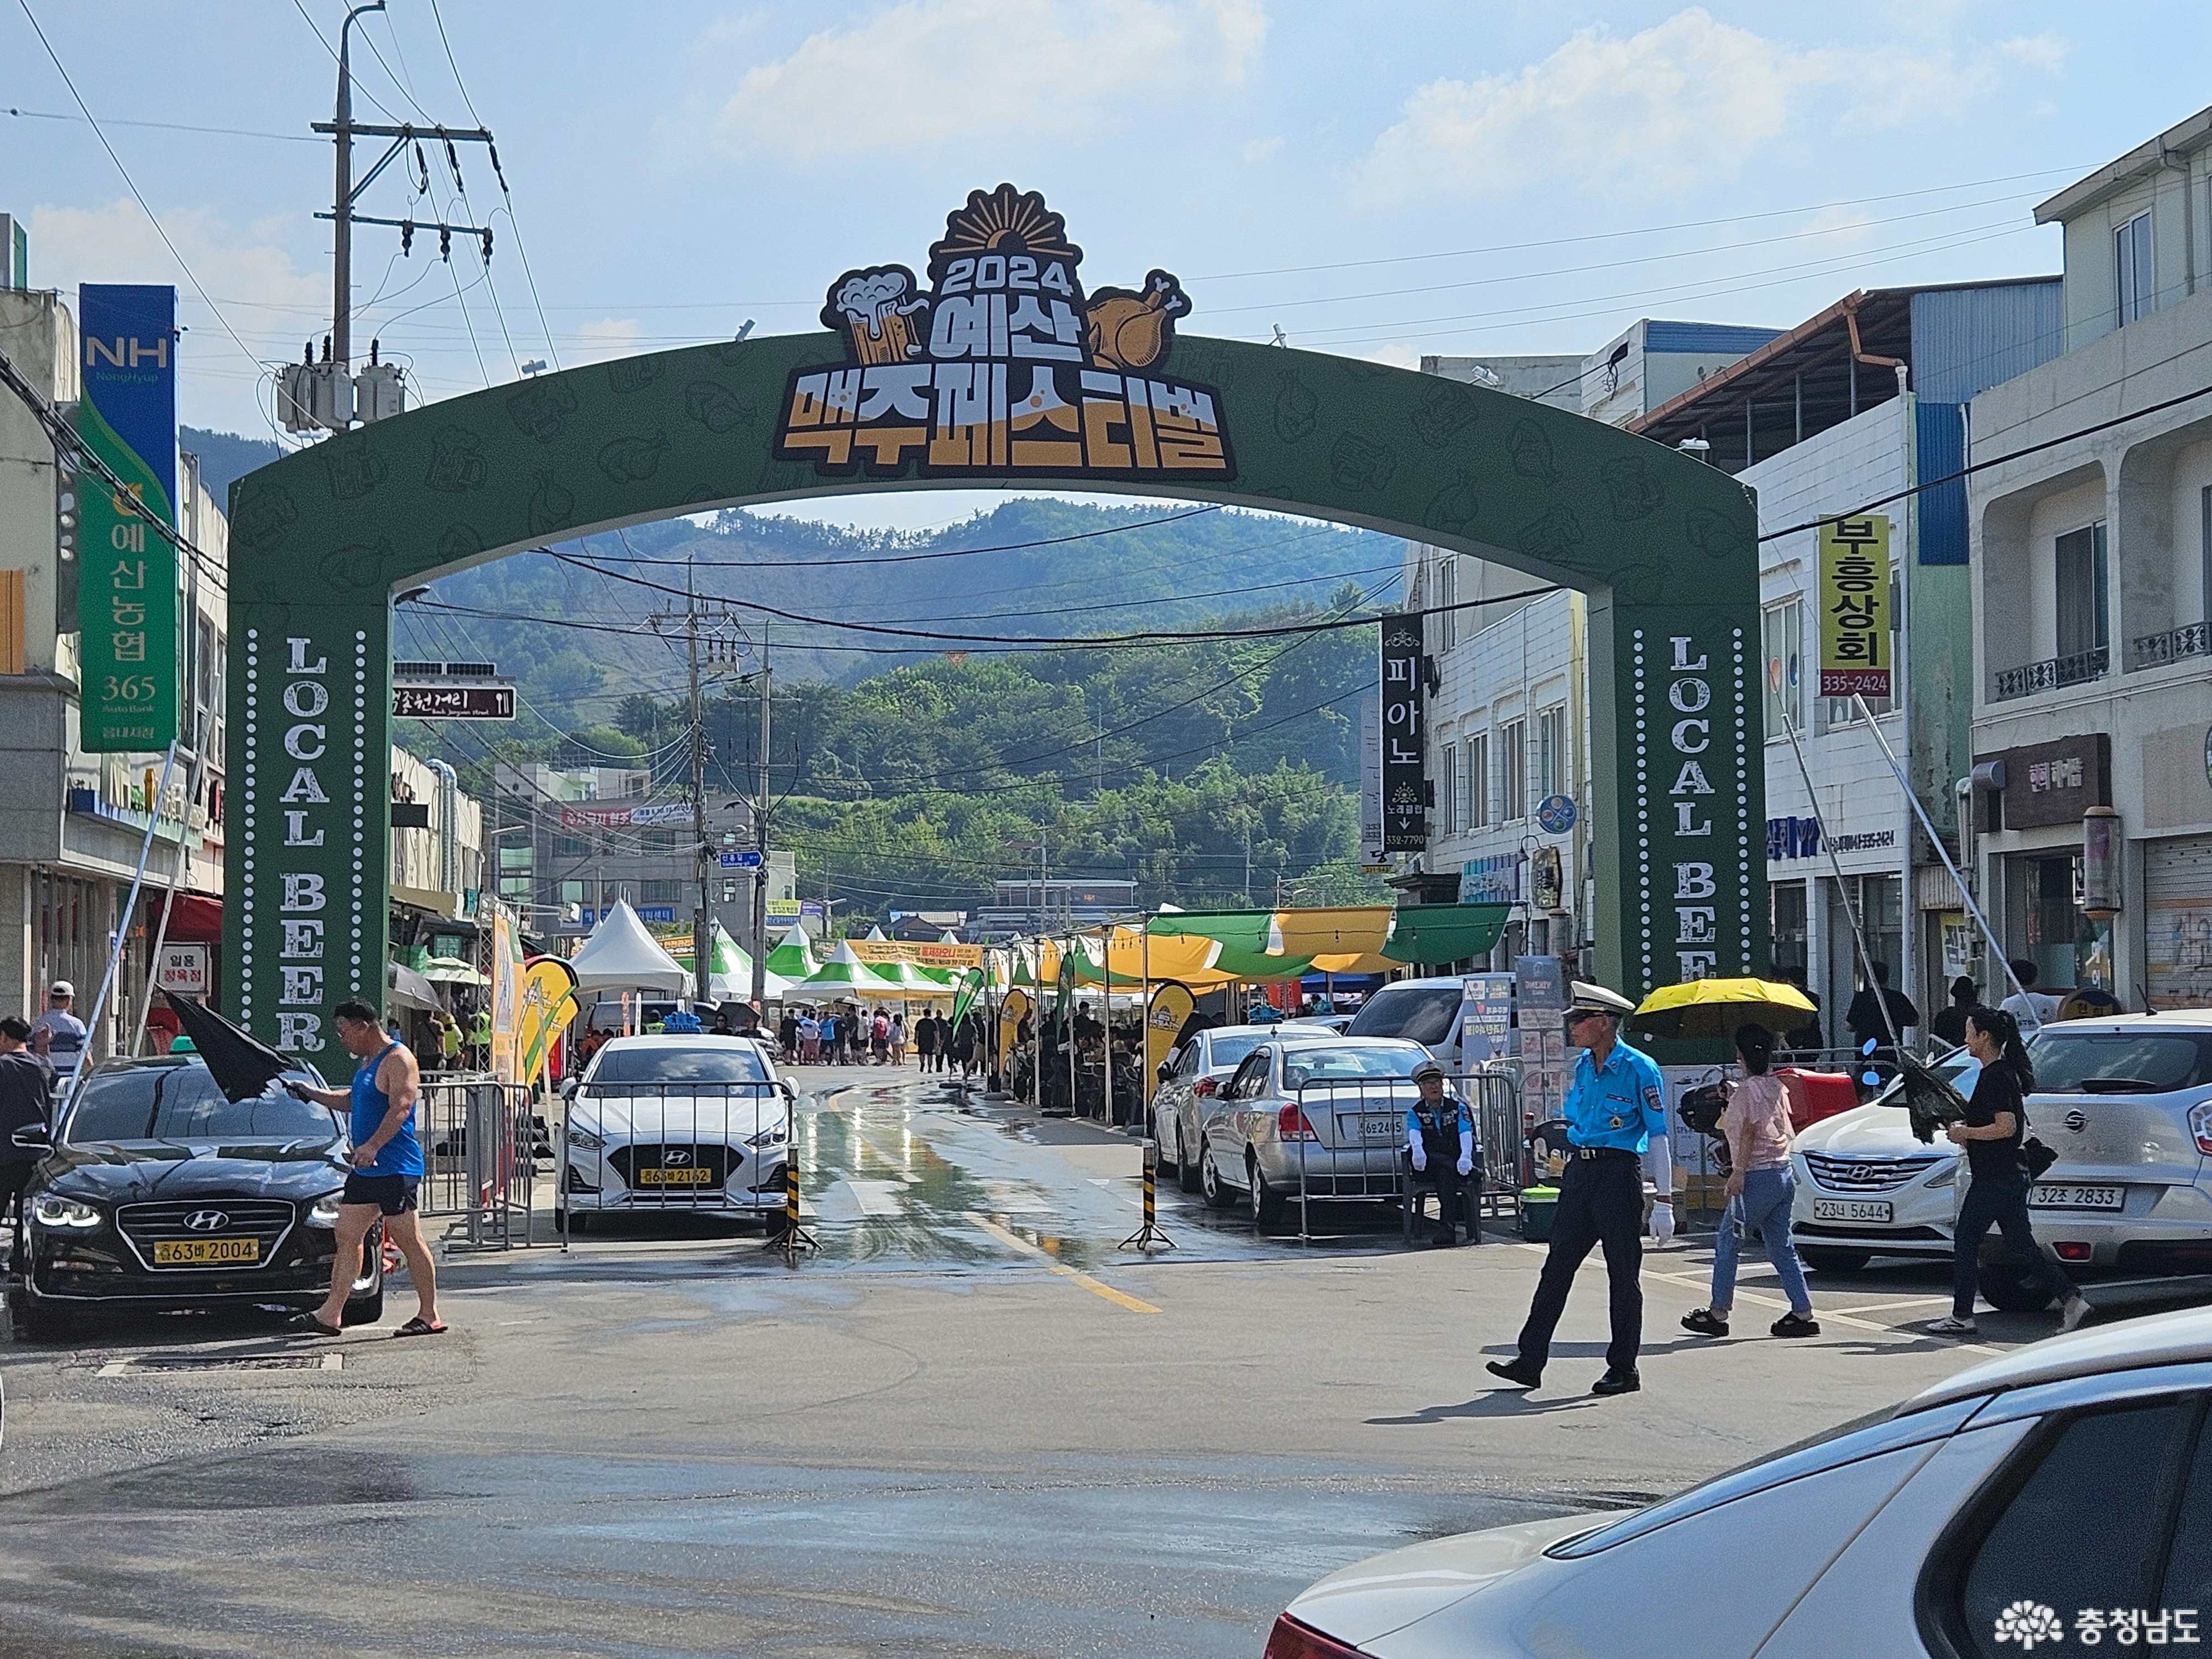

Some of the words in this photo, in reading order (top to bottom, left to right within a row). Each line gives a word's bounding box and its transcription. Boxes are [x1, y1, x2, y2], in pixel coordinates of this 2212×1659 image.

[941, 255, 1074, 296] 2024
[86, 336, 166, 368] NH
[928, 293, 1083, 362] 예산
[96, 372, 158, 385] NongHyup
[784, 362, 1226, 469] 맥주페스티벌
[111, 523, 148, 662] 예산농협
[1830, 520, 1880, 666] 부흥상회
[101, 675, 155, 702] 365
[1386, 656, 1420, 764] 피아노
[1823, 675, 1887, 691] 335-2424
[279, 637, 330, 846] LOCAL
[1668, 637, 1715, 836] LOCAL
[1386, 834, 1424, 845] 332-7790
[1672, 862, 1718, 983] BEE
[275, 873, 327, 1052] BEER
[1851, 1204, 1884, 1218] 5644
[2074, 1188, 2116, 1204] 2833
[172, 1244, 205, 1260] 63바
[209, 1241, 252, 1259] 2004
